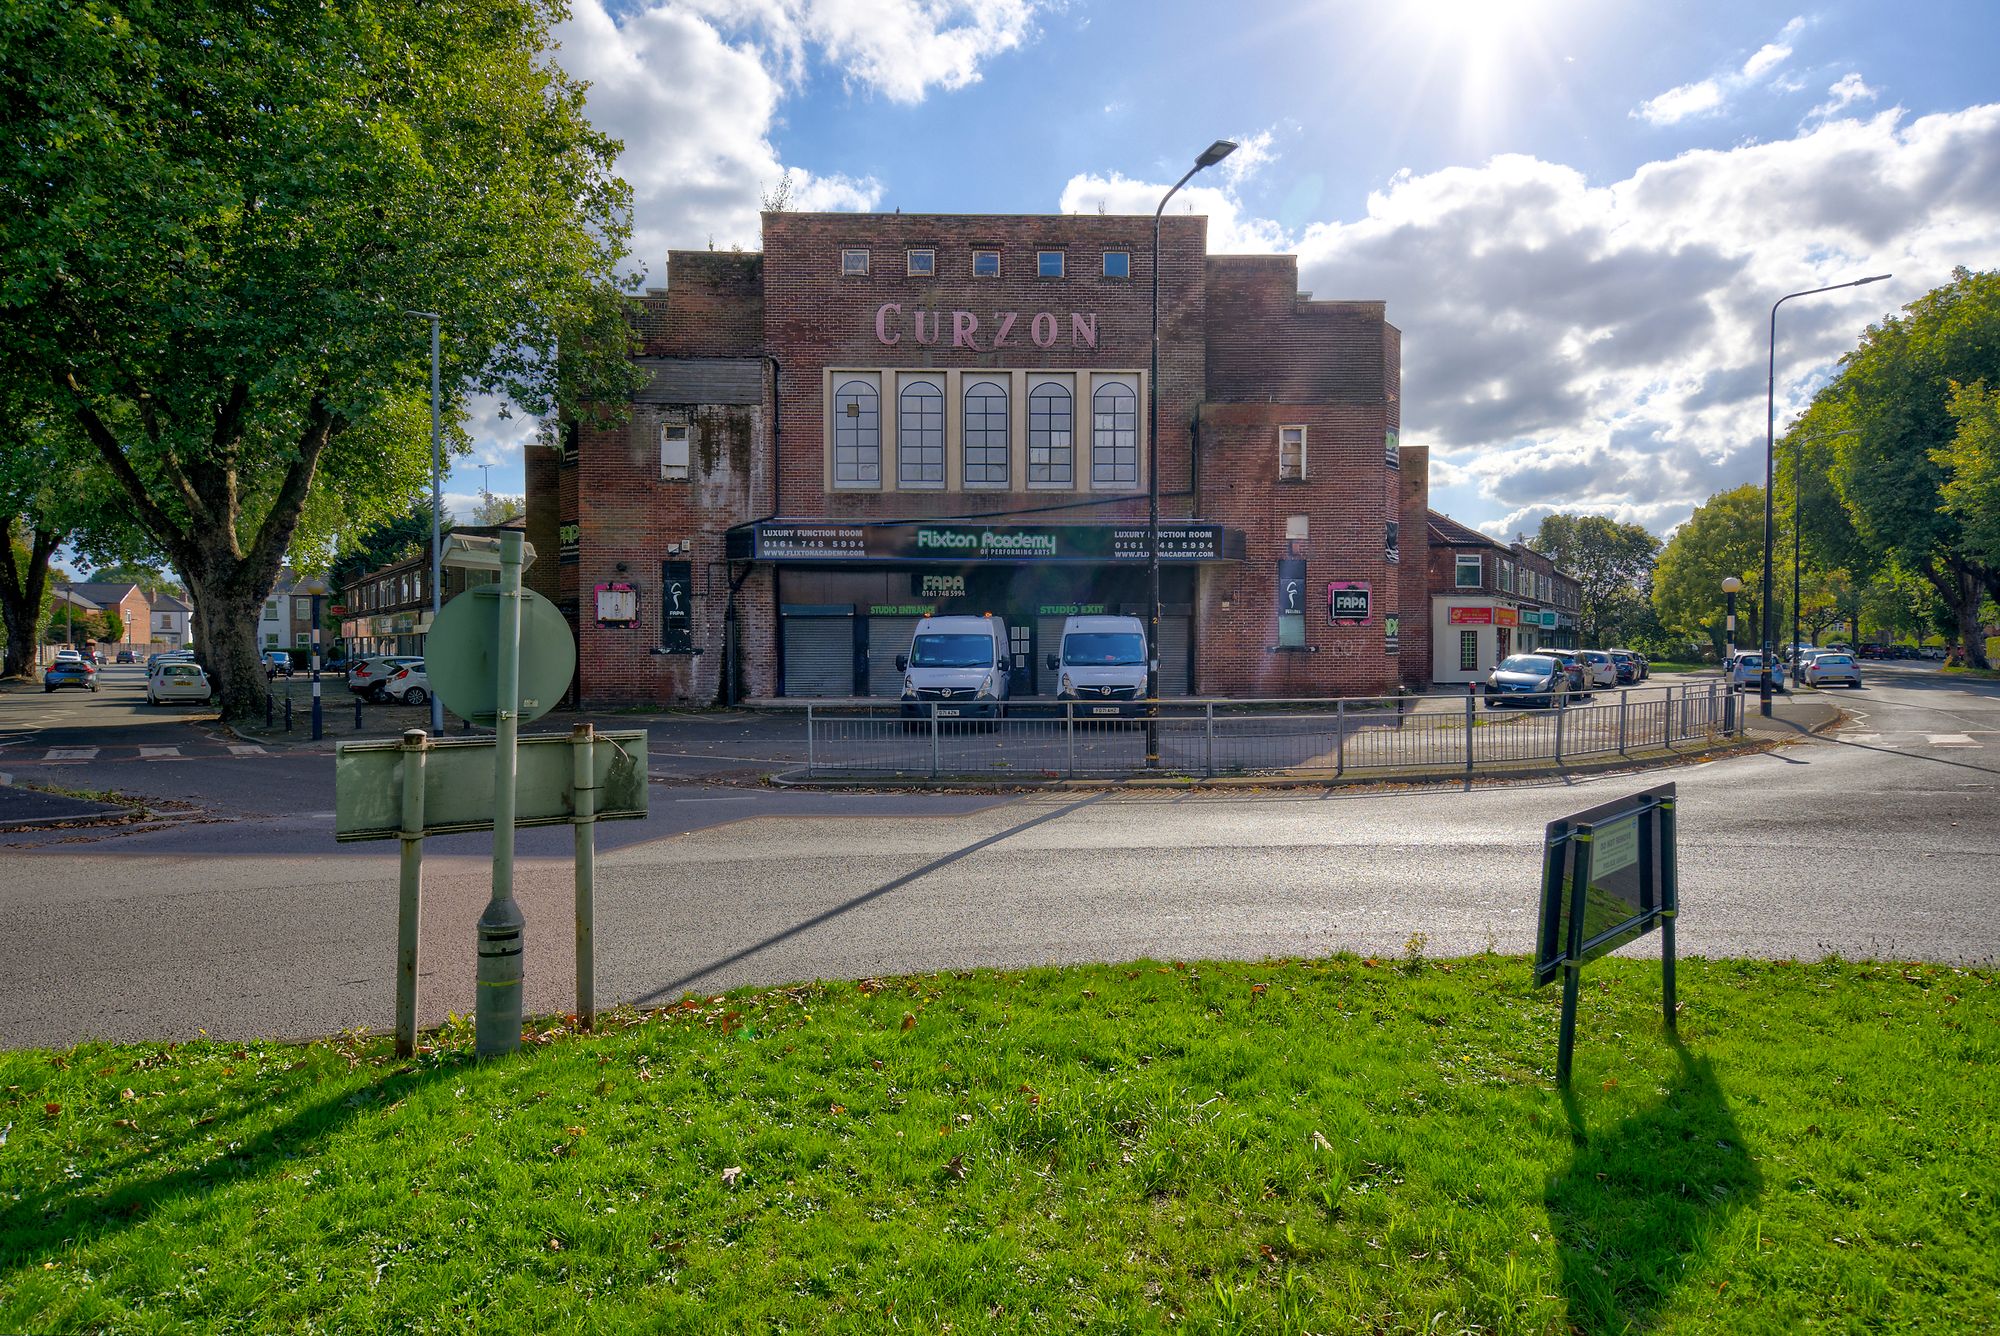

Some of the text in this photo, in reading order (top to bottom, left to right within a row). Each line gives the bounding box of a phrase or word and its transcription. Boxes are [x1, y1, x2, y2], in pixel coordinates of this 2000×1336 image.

[875, 303, 1096, 351] CURZON
[763, 529, 863, 537] LUXURY FUNCTION ROOM
[763, 540, 865, 548] 0161 748 5994
[918, 530, 1056, 555] Flixton Academy
[922, 575, 965, 590] FAPA
[1336, 597, 1367, 609] FAPA
[870, 605, 936, 614] STUDIO ENTRANCE
[1040, 604, 1105, 614] STUDIO EXIT
